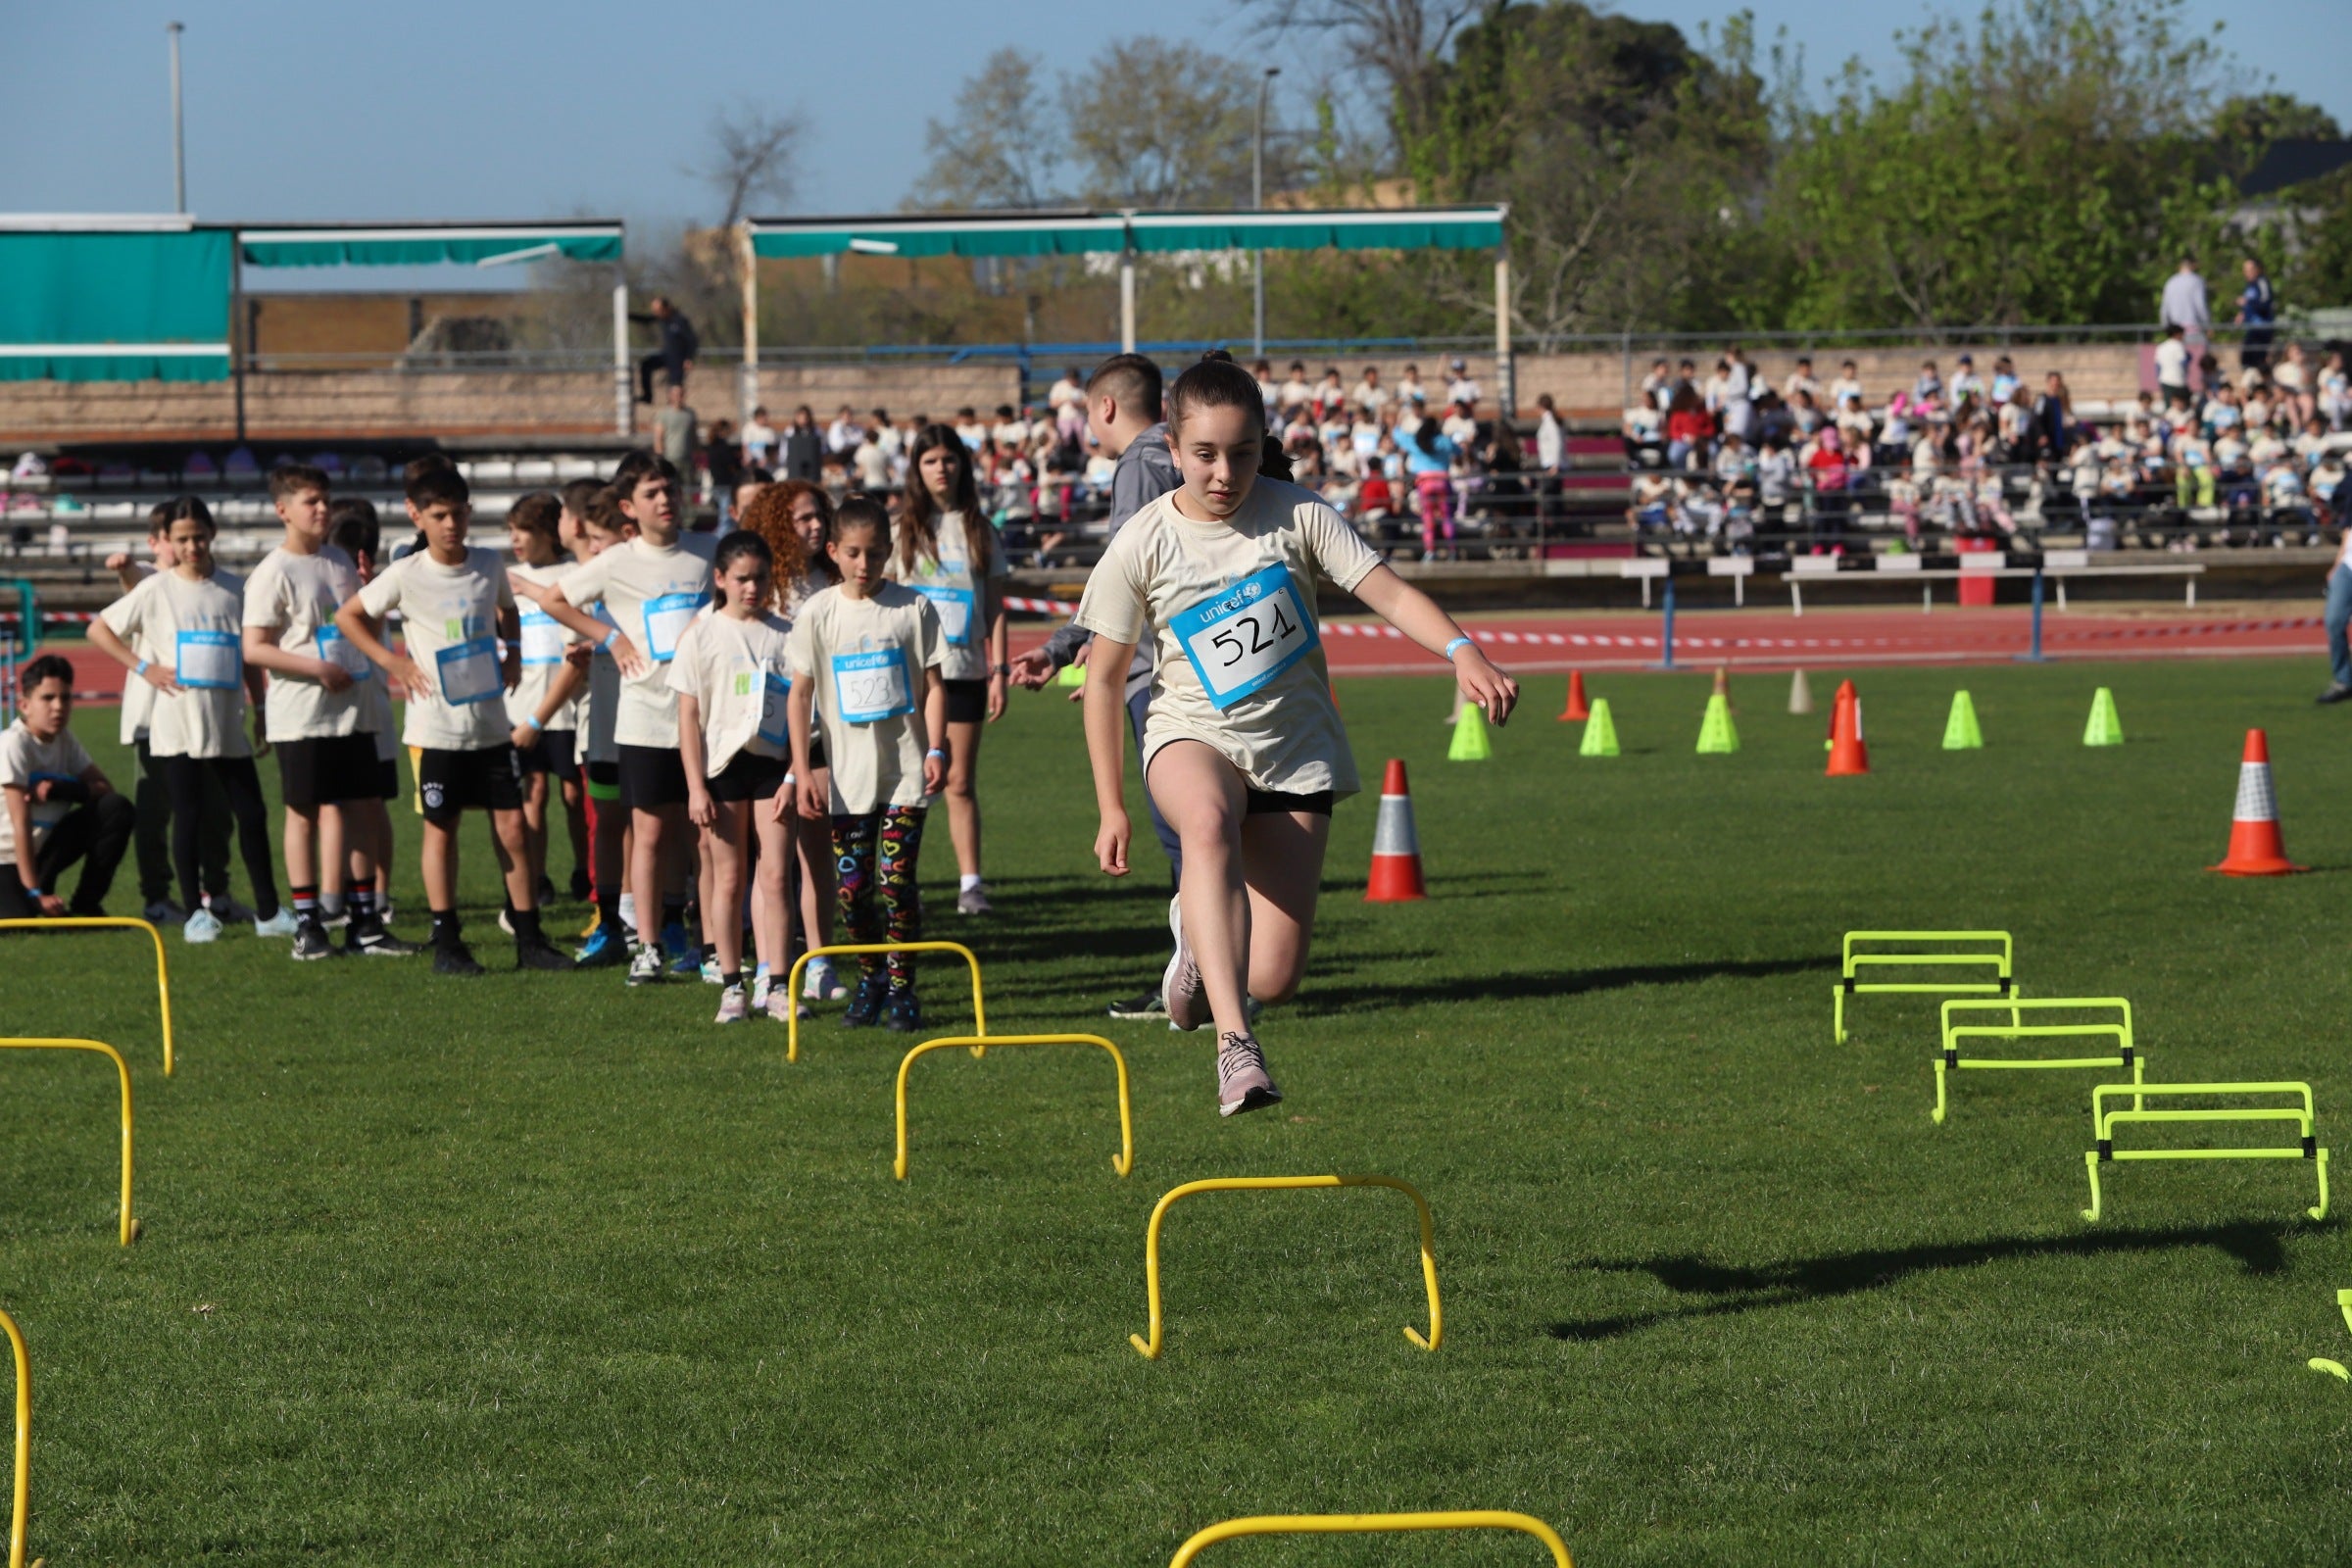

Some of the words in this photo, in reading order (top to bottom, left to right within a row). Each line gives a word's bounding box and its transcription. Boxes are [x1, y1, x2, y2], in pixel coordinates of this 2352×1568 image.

[1200, 589, 1244, 623] unicef
[1211, 603, 1297, 667] 521
[845, 655, 877, 669] unicef
[851, 676, 891, 707] 523
